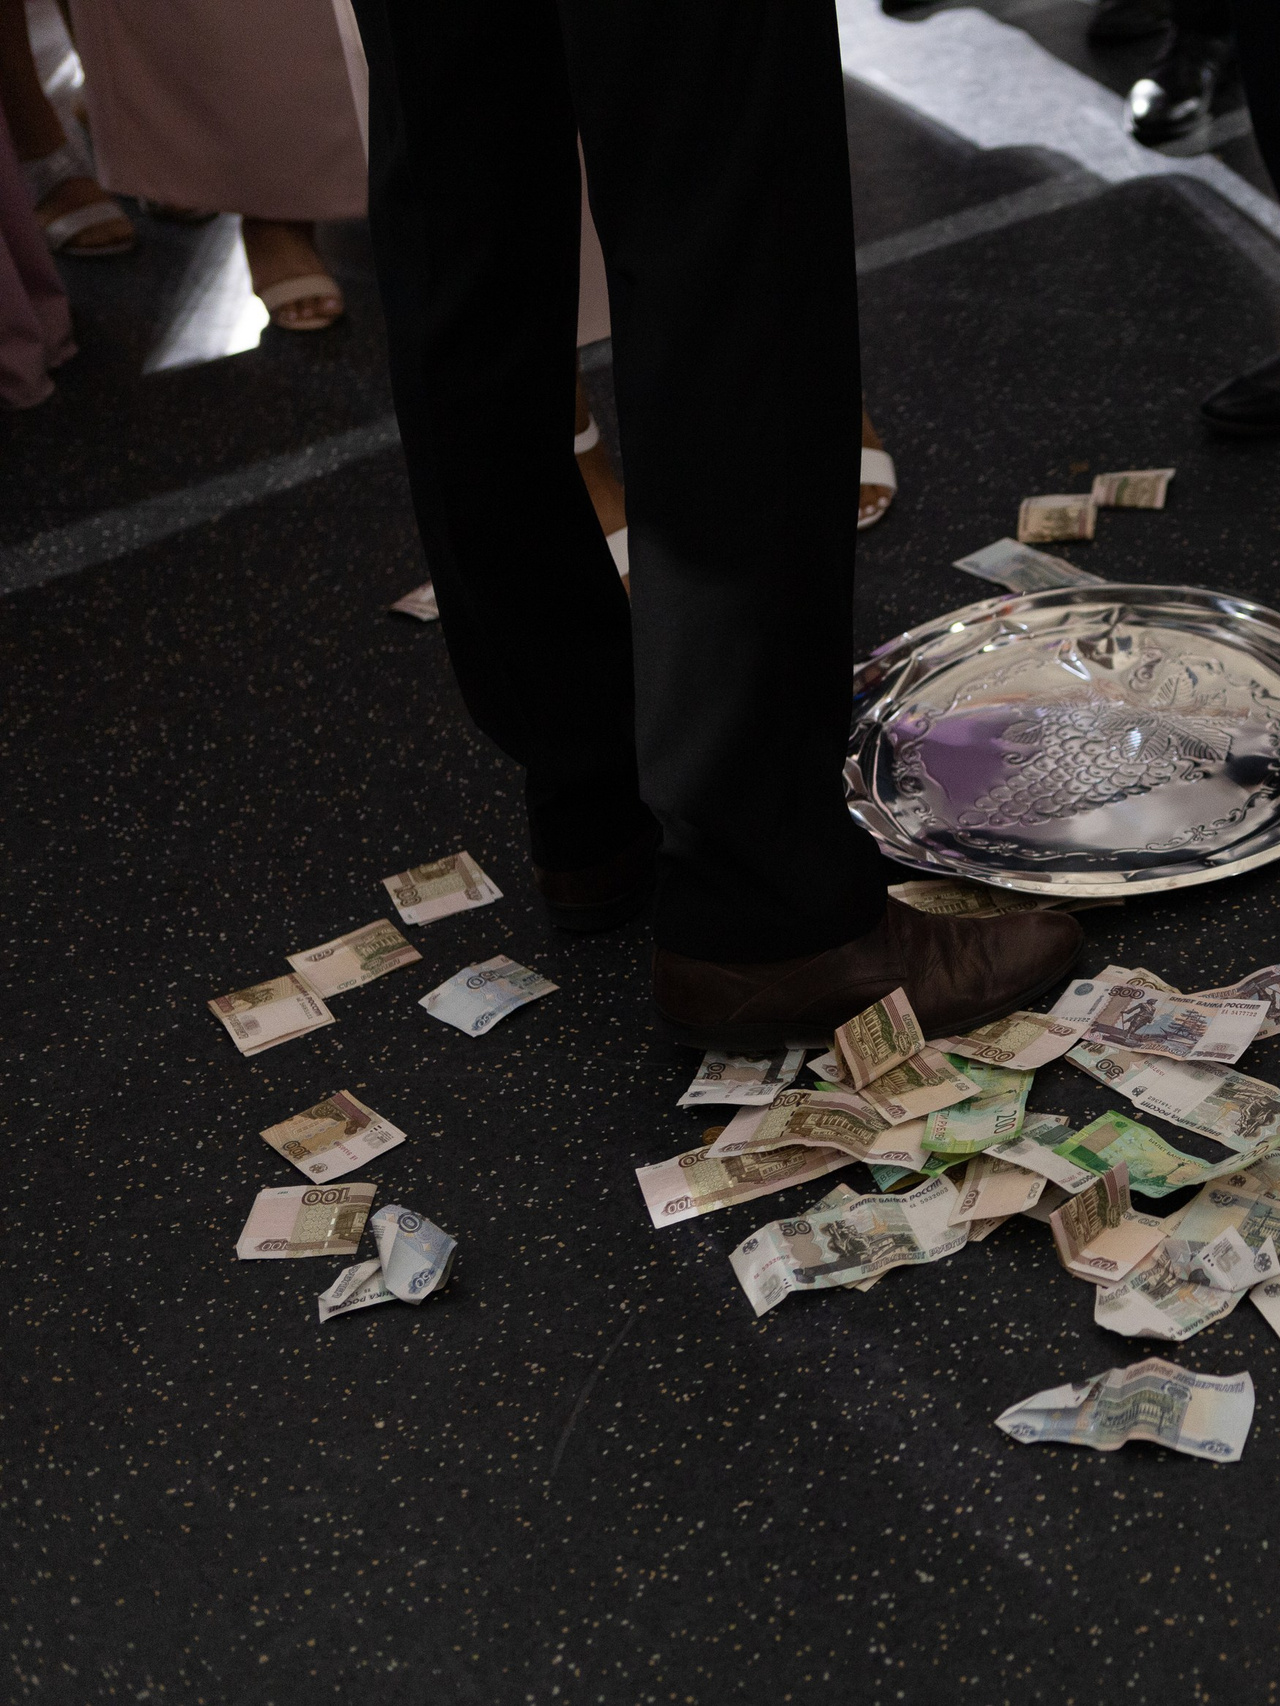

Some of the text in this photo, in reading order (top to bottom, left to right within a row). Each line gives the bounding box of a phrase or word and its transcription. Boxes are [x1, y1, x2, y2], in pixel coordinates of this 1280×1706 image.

[1108, 985, 1146, 1000] 500
[1197, 1000, 1224, 1009] БАНКА
[1224, 1002, 1261, 1011] РОССИИ
[974, 1045, 1016, 1063] 100
[1096, 1058, 1125, 1080] 50
[282, 1140, 312, 1159] 100
[301, 1186, 351, 1205] 100
[909, 1178, 943, 1202] РОССИИ
[667, 1199, 694, 1215] 100
[780, 1219, 812, 1237] 50
[260, 1239, 289, 1251] 100
